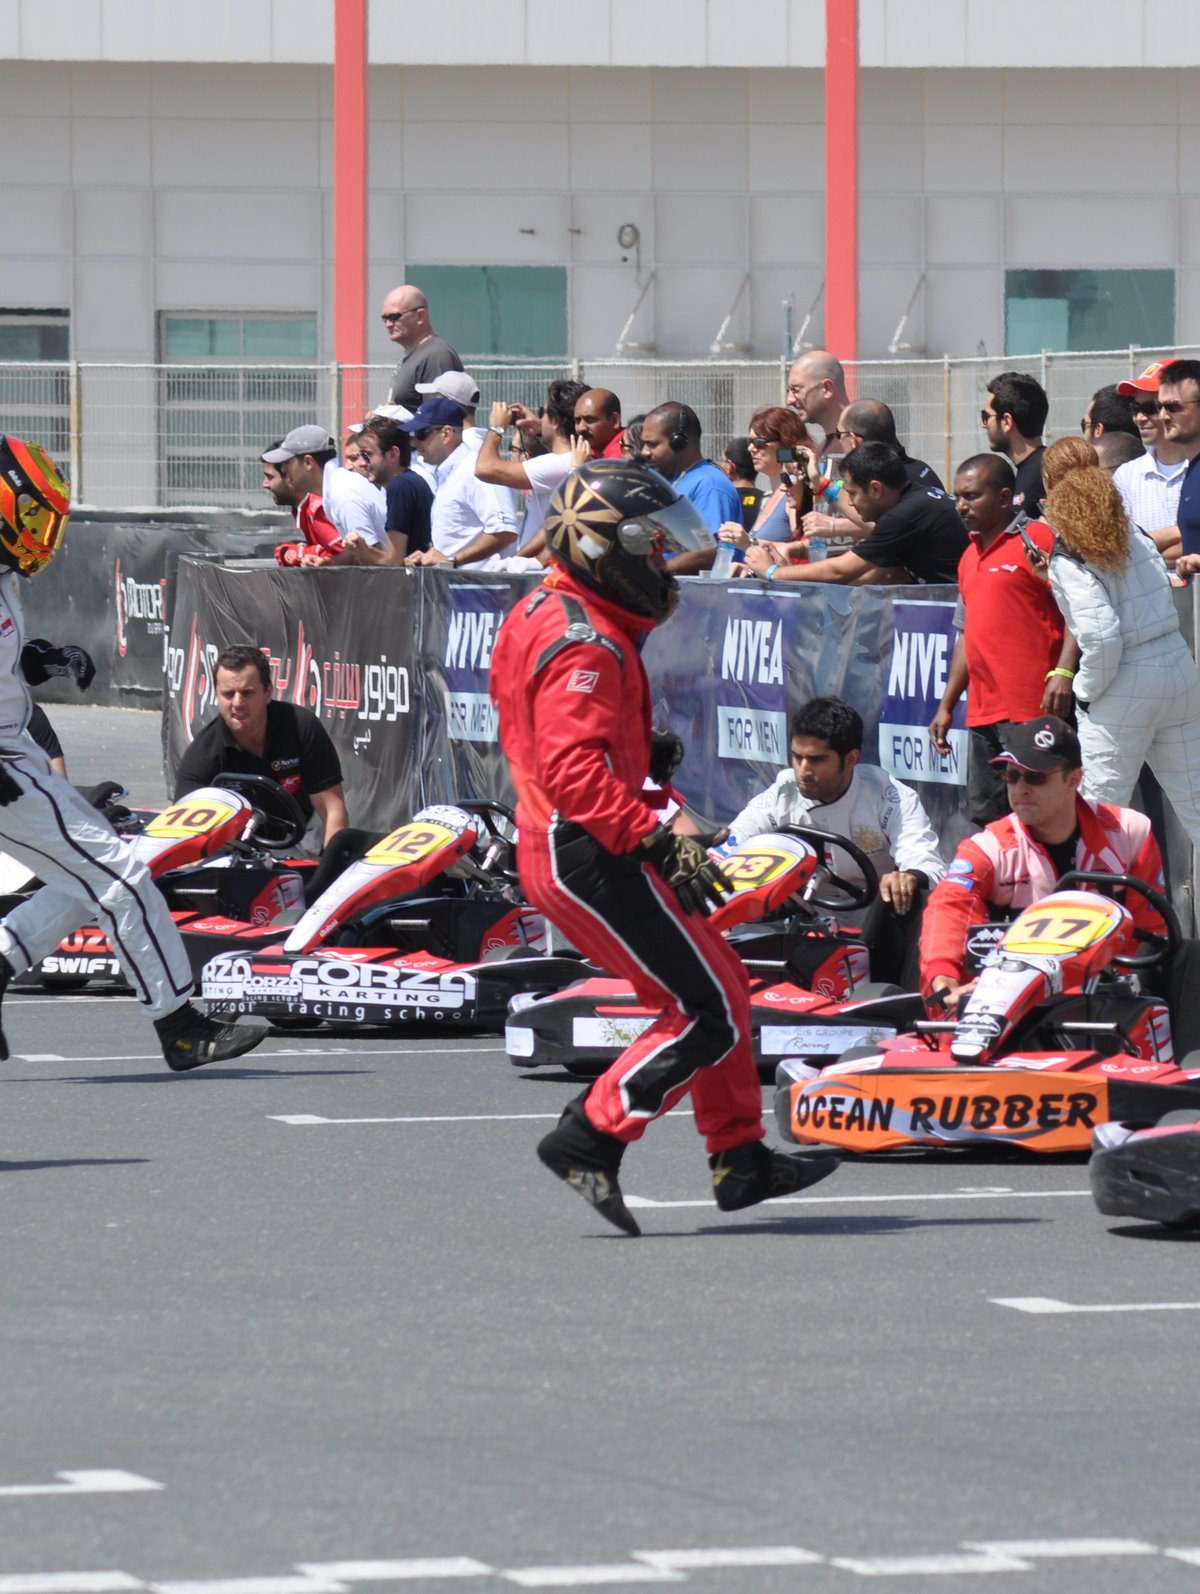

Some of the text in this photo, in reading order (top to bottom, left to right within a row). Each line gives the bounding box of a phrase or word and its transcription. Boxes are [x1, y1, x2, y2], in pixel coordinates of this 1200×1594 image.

[722, 615, 784, 685] NIVEA
[888, 627, 967, 701] NIVE
[727, 717, 780, 754] FOR MEN
[892, 735, 959, 774] FOR MEN
[165, 808, 217, 828] 10
[385, 830, 436, 855] 12
[1025, 918, 1093, 940] 17
[41, 957, 120, 975] SWIFT
[243, 976, 303, 992] FORZA
[290, 959, 477, 1000] FORZA
[319, 988, 441, 1003] KARTING
[288, 1003, 475, 1020] racing school
[796, 1092, 1098, 1132] OCEAN RUBBER
